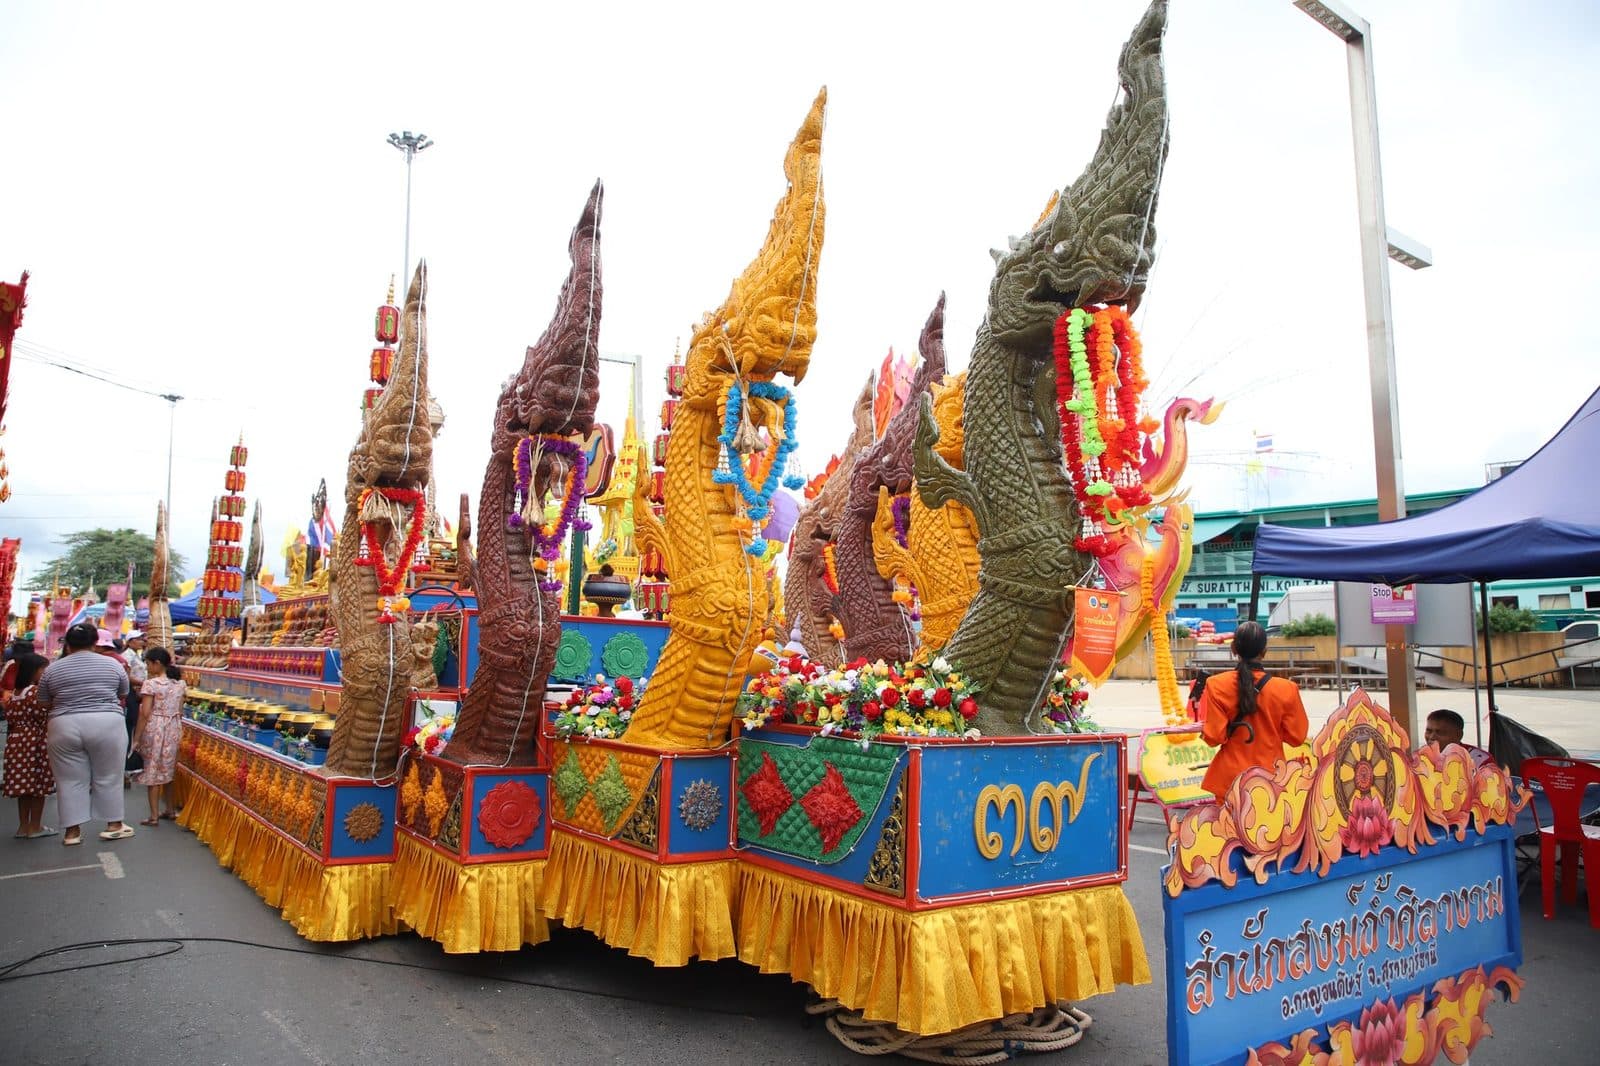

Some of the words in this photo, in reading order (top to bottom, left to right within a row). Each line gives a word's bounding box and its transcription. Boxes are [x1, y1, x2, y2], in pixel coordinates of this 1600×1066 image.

[1373, 587, 1391, 599] Stop
[1185, 872, 1504, 1015] สำนักสงฆ์ถ้ำศิลางาม
